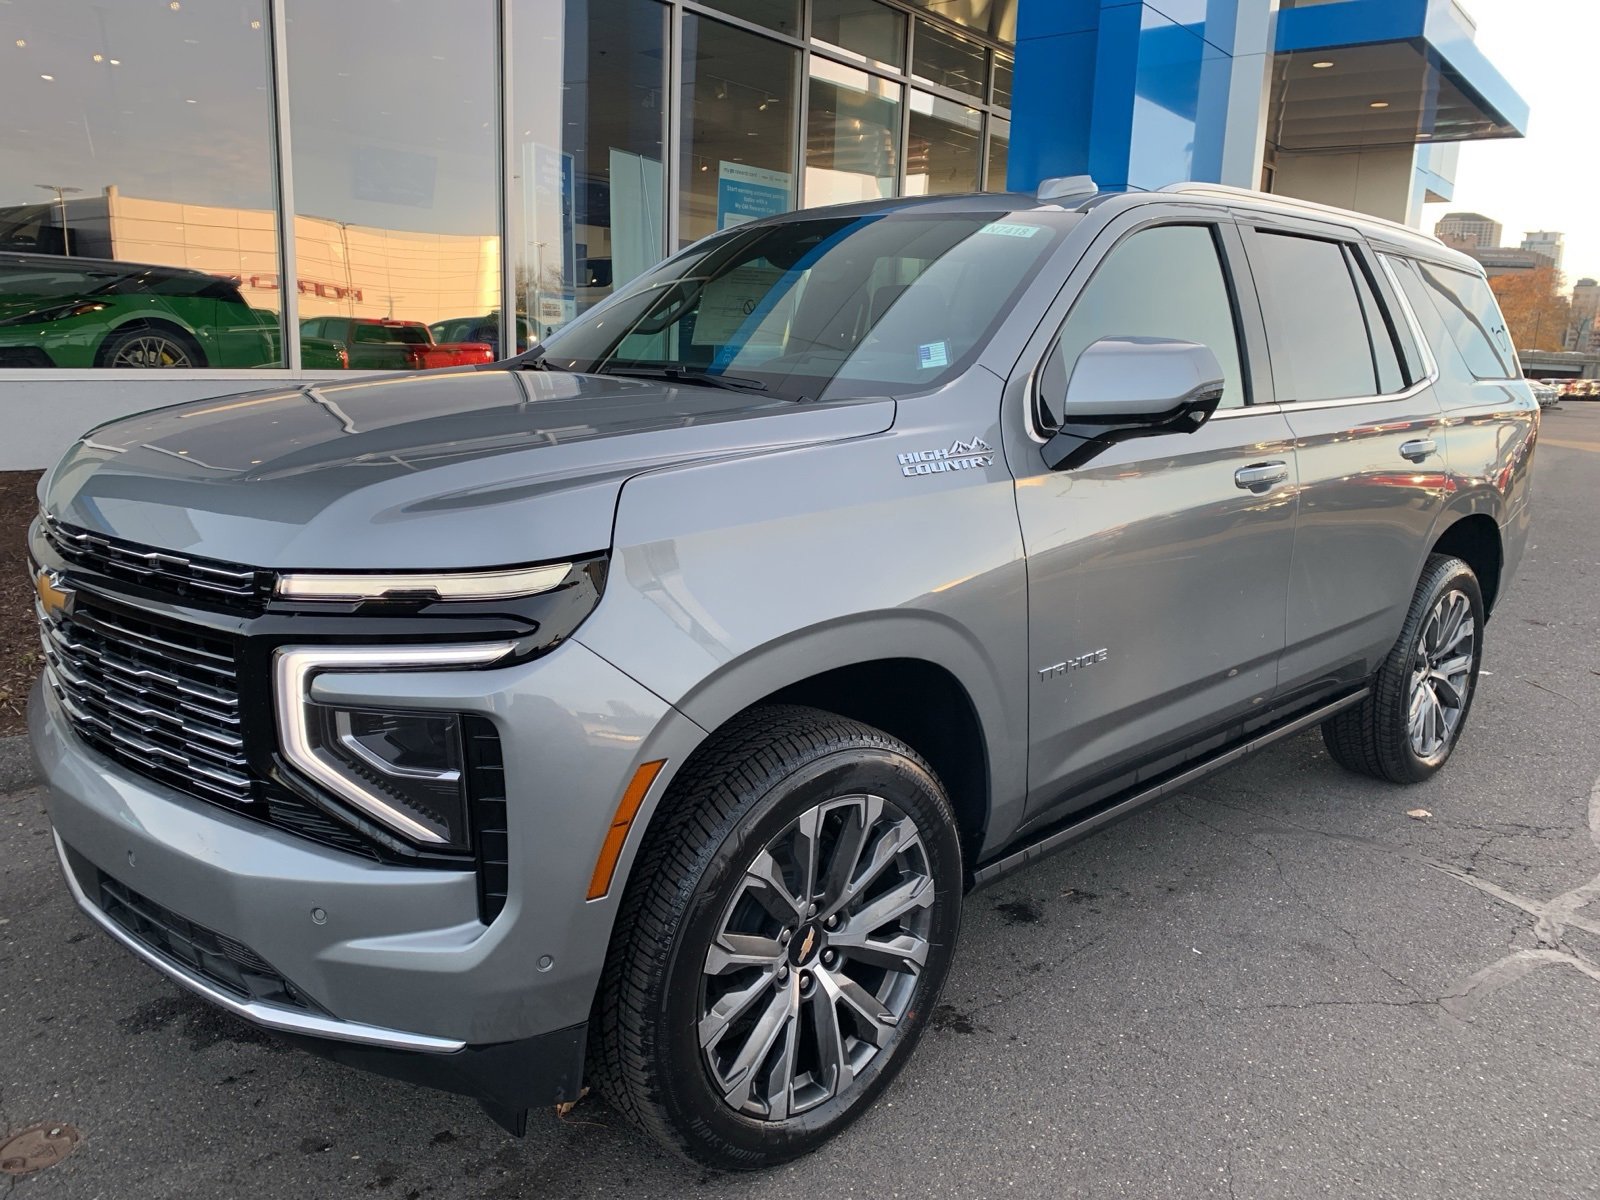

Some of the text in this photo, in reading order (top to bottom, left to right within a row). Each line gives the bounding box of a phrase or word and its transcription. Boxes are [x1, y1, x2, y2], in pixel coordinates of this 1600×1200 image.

[726, 184, 738, 192] Start
[897, 448, 949, 465] HIGH
[901, 455, 995, 477] COUNTRY
[1037, 648, 1108, 683] TAHOE
